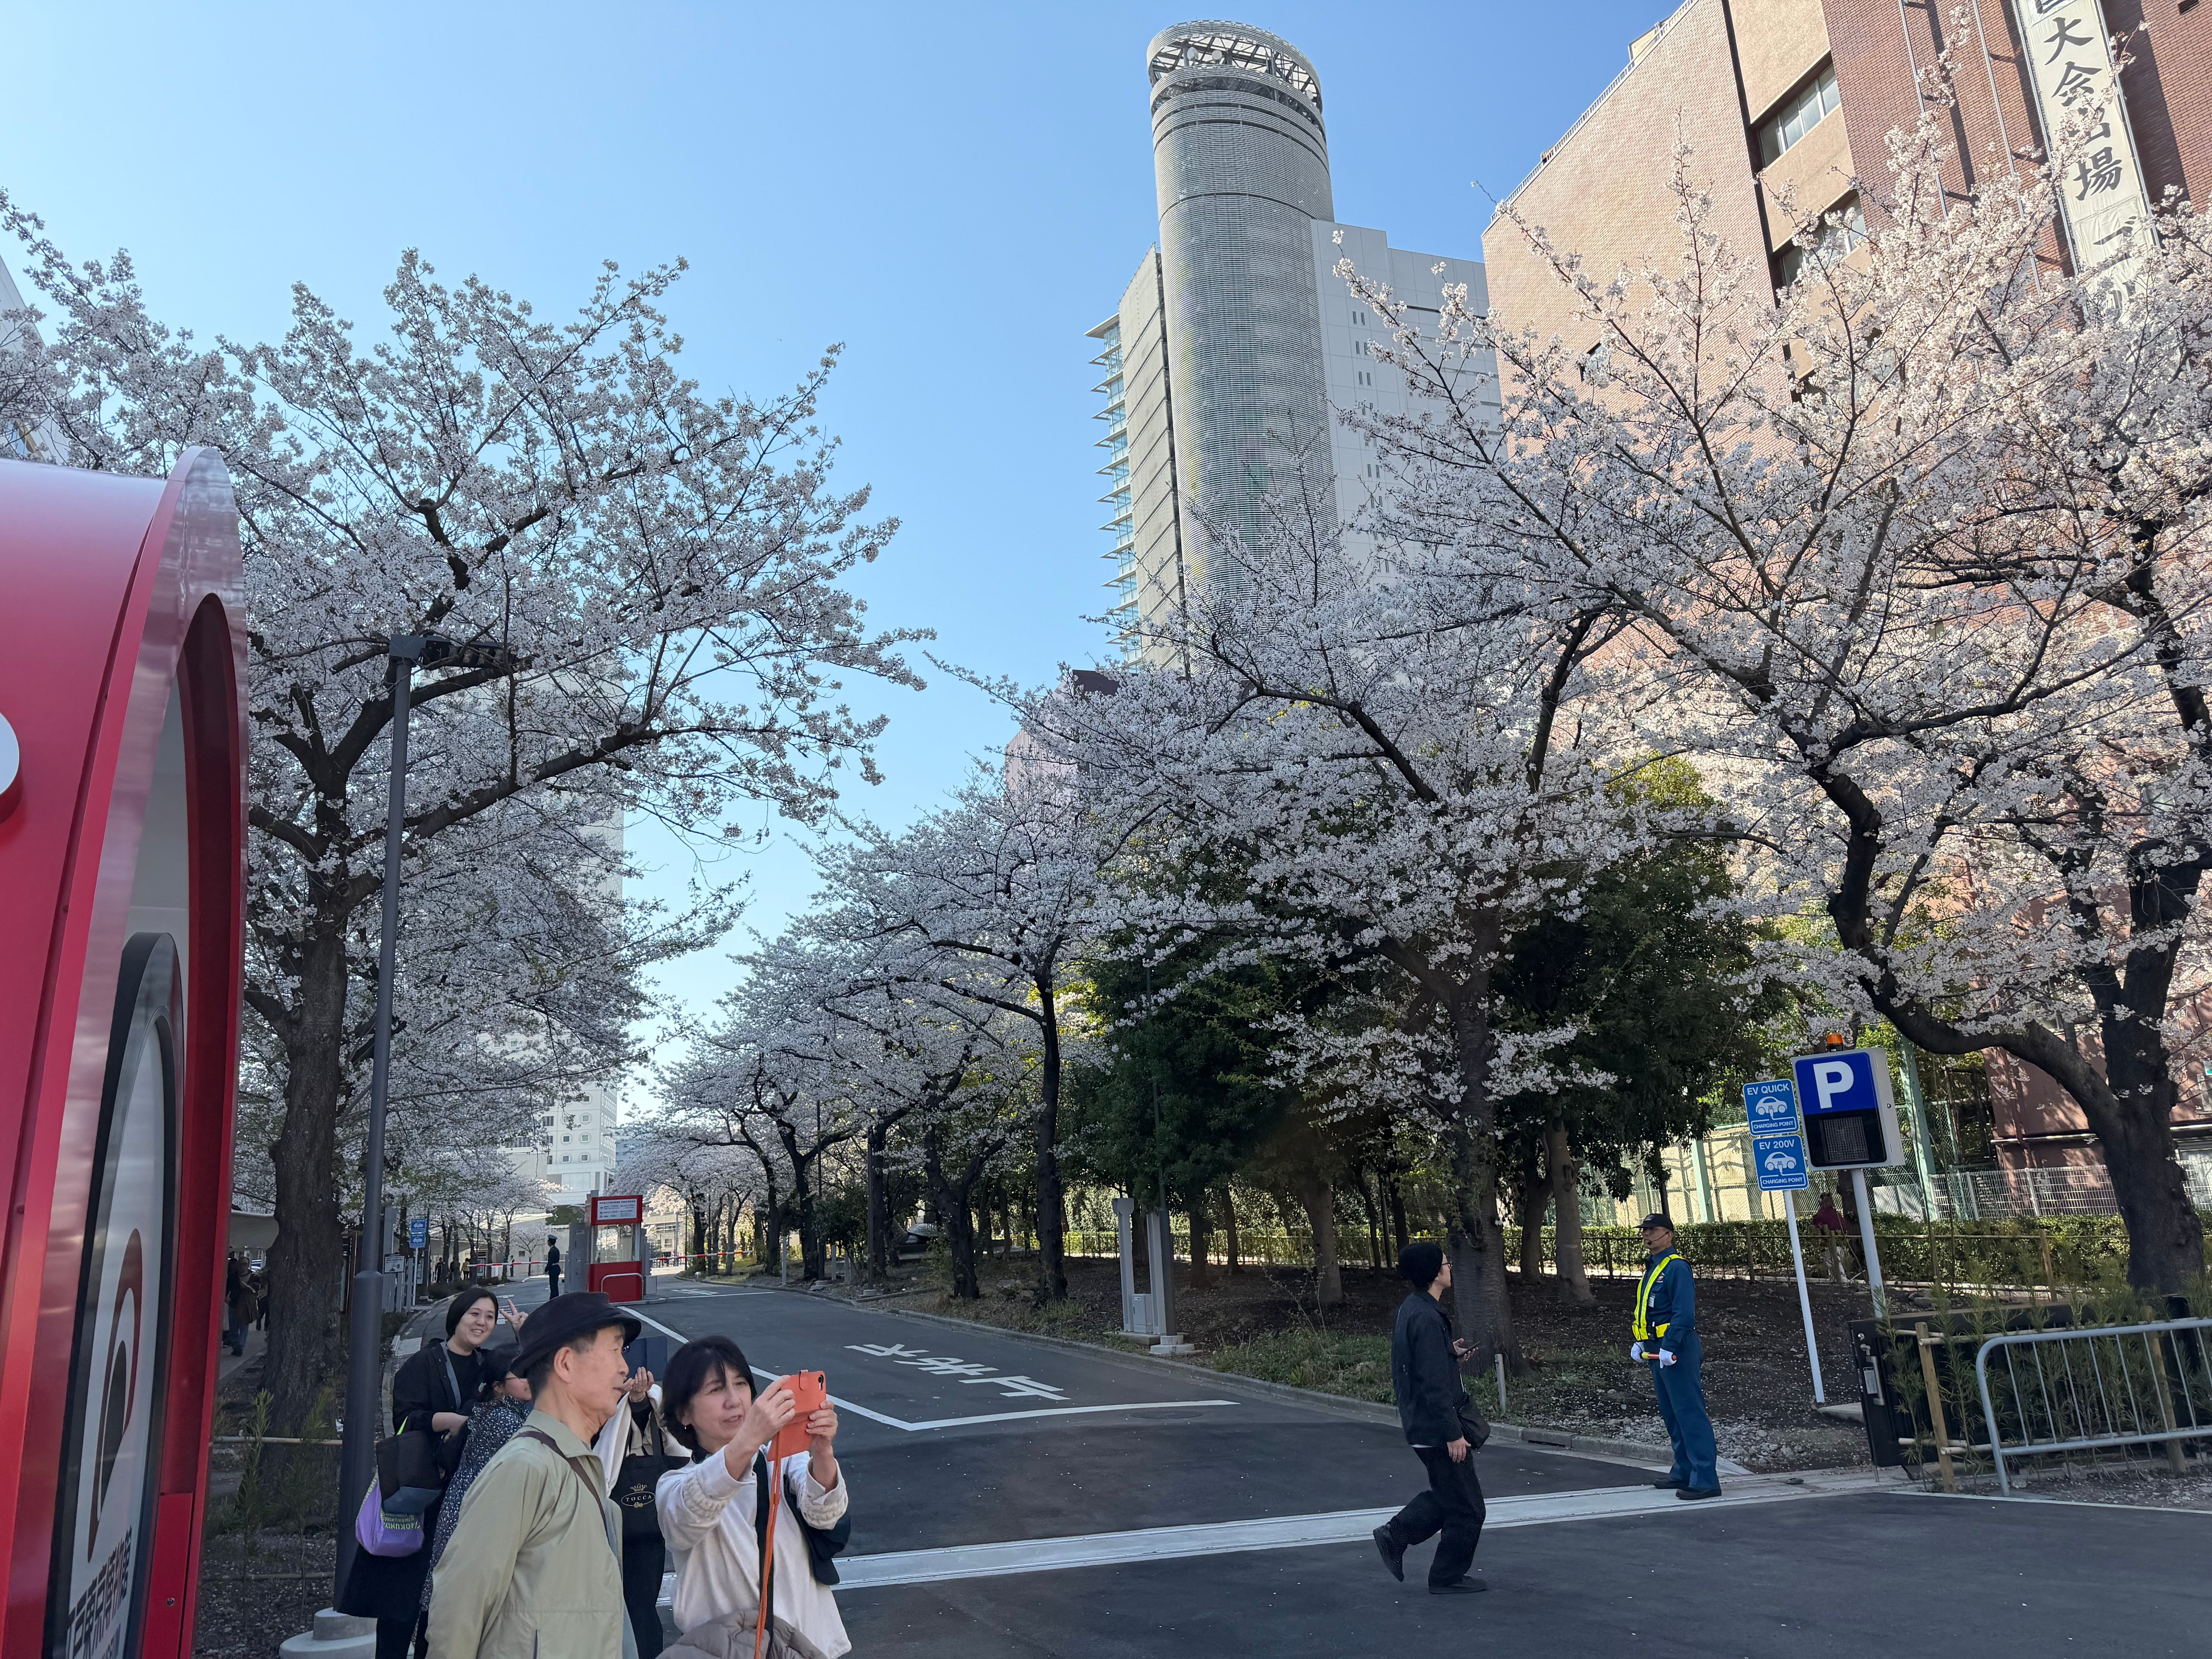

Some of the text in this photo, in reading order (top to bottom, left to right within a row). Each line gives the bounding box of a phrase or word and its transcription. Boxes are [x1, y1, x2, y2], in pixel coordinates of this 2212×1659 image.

[2035, 0, 2122, 200] 大会出場
[1747, 1083, 1790, 1095] EV QUICK
[1813, 1061, 1854, 1109] P
[1759, 1139, 1795, 1150] EV 200V
[843, 1343, 1072, 1400] 止まれ
